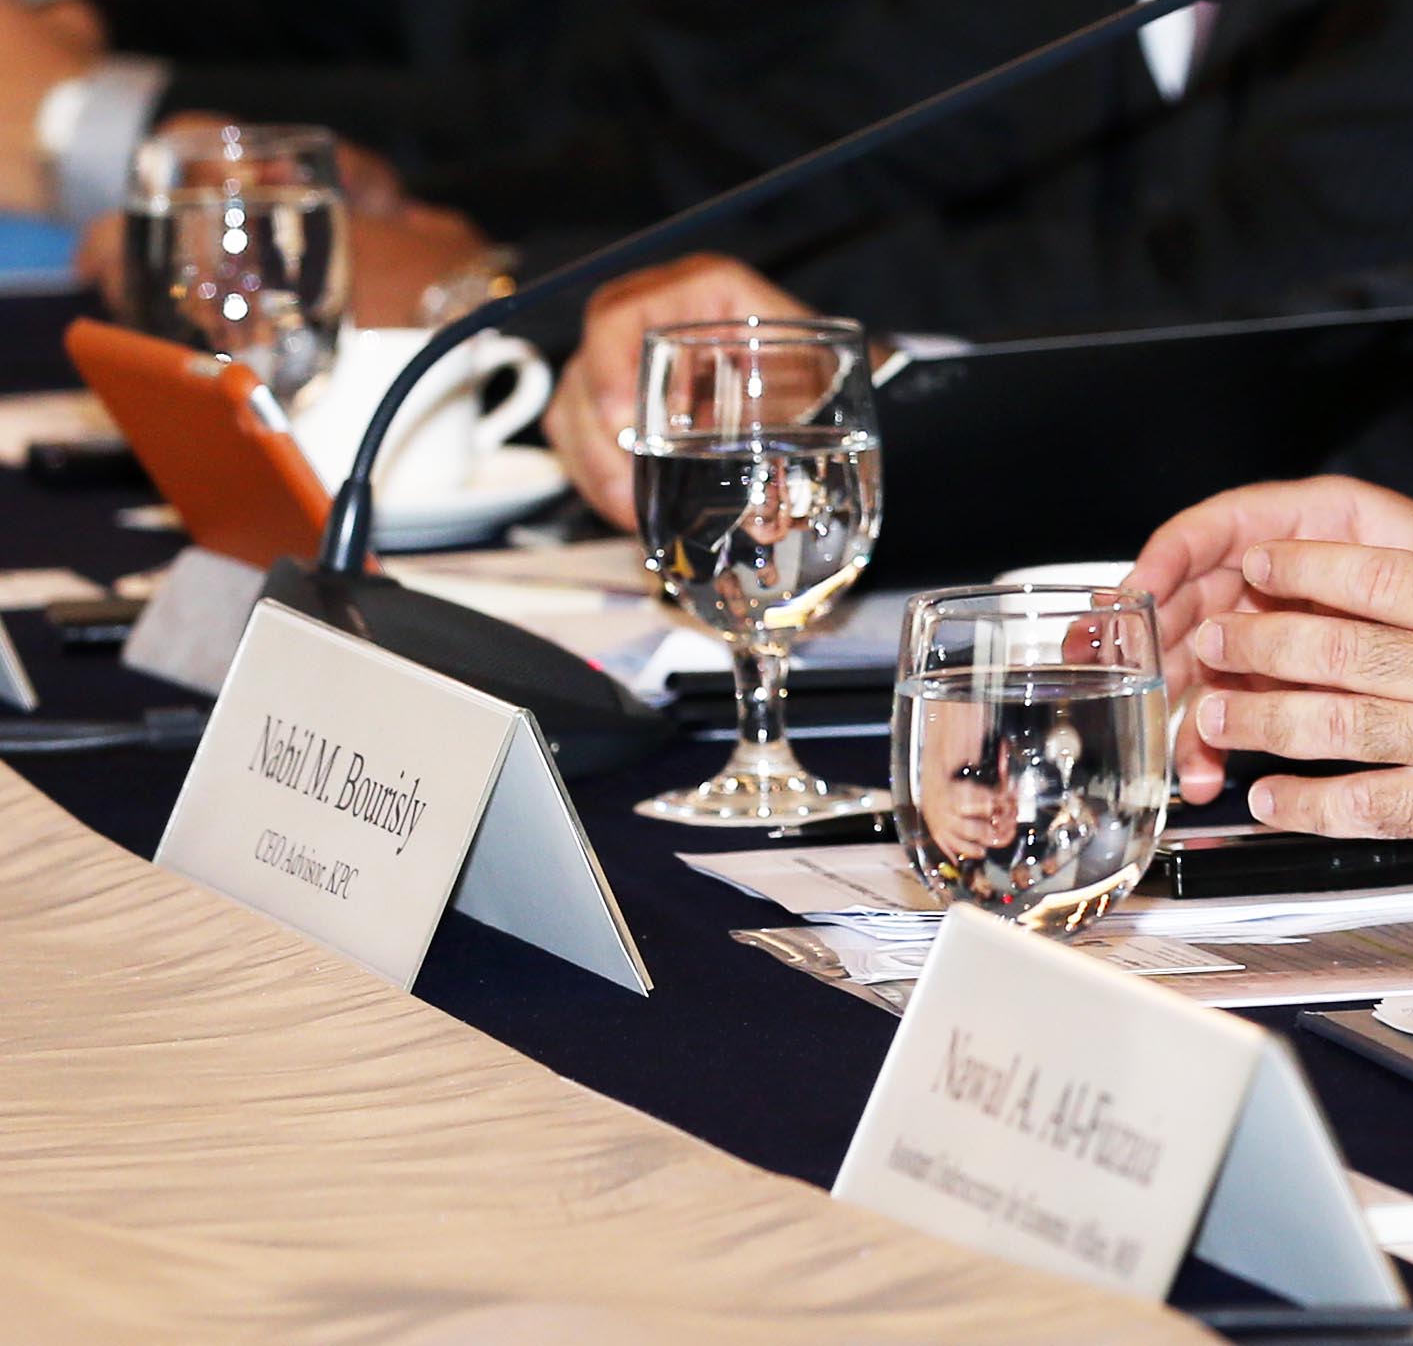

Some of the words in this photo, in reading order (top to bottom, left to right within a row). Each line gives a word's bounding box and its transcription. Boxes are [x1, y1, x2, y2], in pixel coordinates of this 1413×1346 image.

[249, 715, 315, 790] Nabil
[303, 738, 342, 804] M.
[334, 751, 427, 856] Bourisly
[255, 828, 287, 868] CEO
[325, 860, 359, 900] KPC
